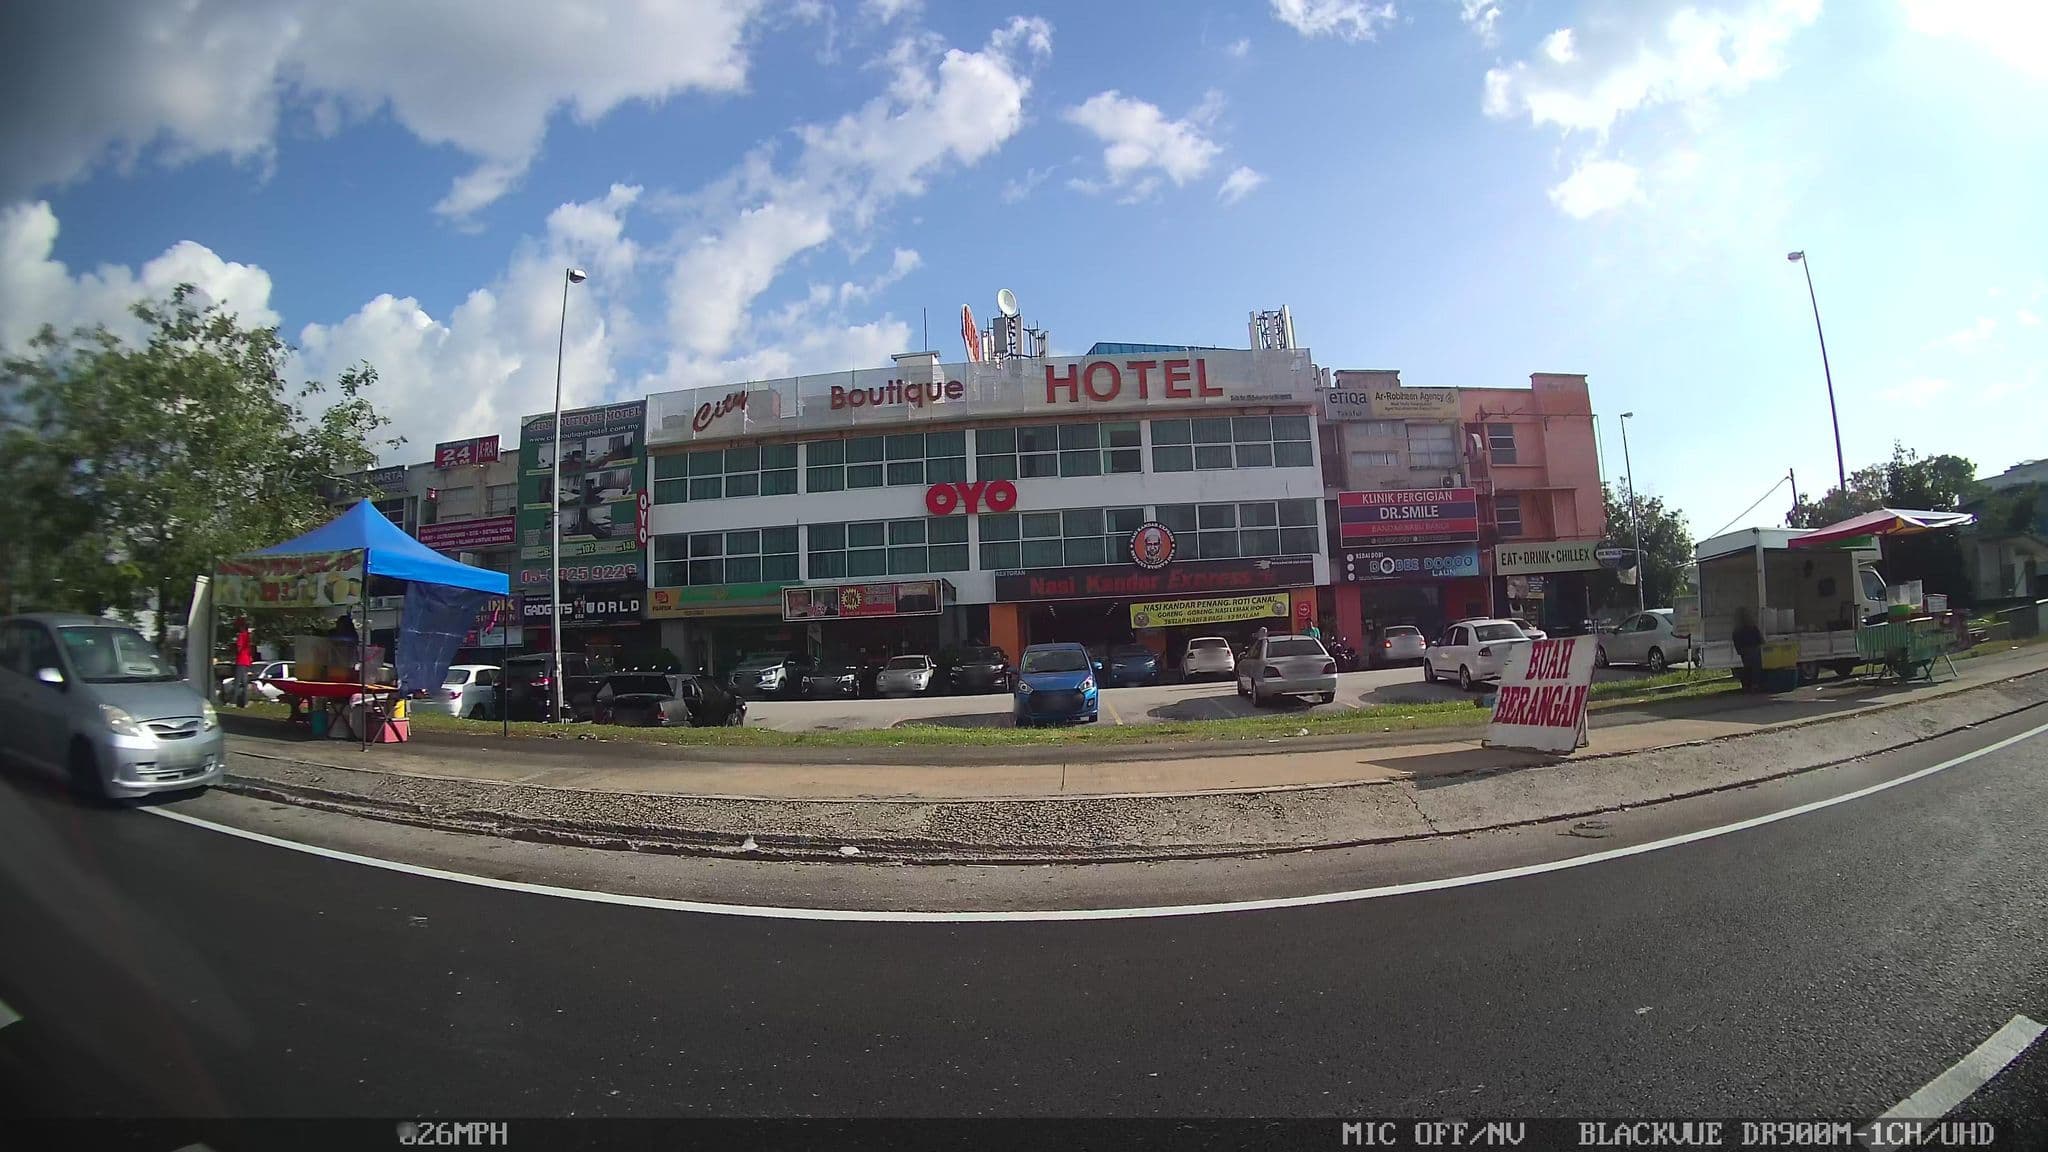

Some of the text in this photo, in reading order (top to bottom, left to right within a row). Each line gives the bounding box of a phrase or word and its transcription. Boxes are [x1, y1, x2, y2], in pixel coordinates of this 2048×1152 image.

[692, 358, 1223, 433] City Boutique HOTEL
[559, 412, 605, 427] OUTIQUE
[442, 448, 471, 461] 24
[925, 479, 1018, 516] OYO
[1362, 491, 1453, 505] KLINIK PERGIGIAN
[1380, 505, 1439, 520] DR.SMILE
[1501, 552, 1518, 566] EAT
[1524, 551, 1550, 565] DRINK
[1556, 549, 1590, 563] CHILLEX
[1030, 569, 1249, 595] Nasi Kandar Express
[524, 603, 573, 616] GADGTS
[586, 600, 640, 614] WORLD
[1143, 602, 1162, 612] NASI
[1163, 601, 1196, 611] KANDAR
[1233, 598, 1250, 606] ROTI
[1158, 610, 1183, 618] GORENG
[1525, 639, 1576, 681] BUAH
[1491, 685, 1587, 730] BERANGAN
